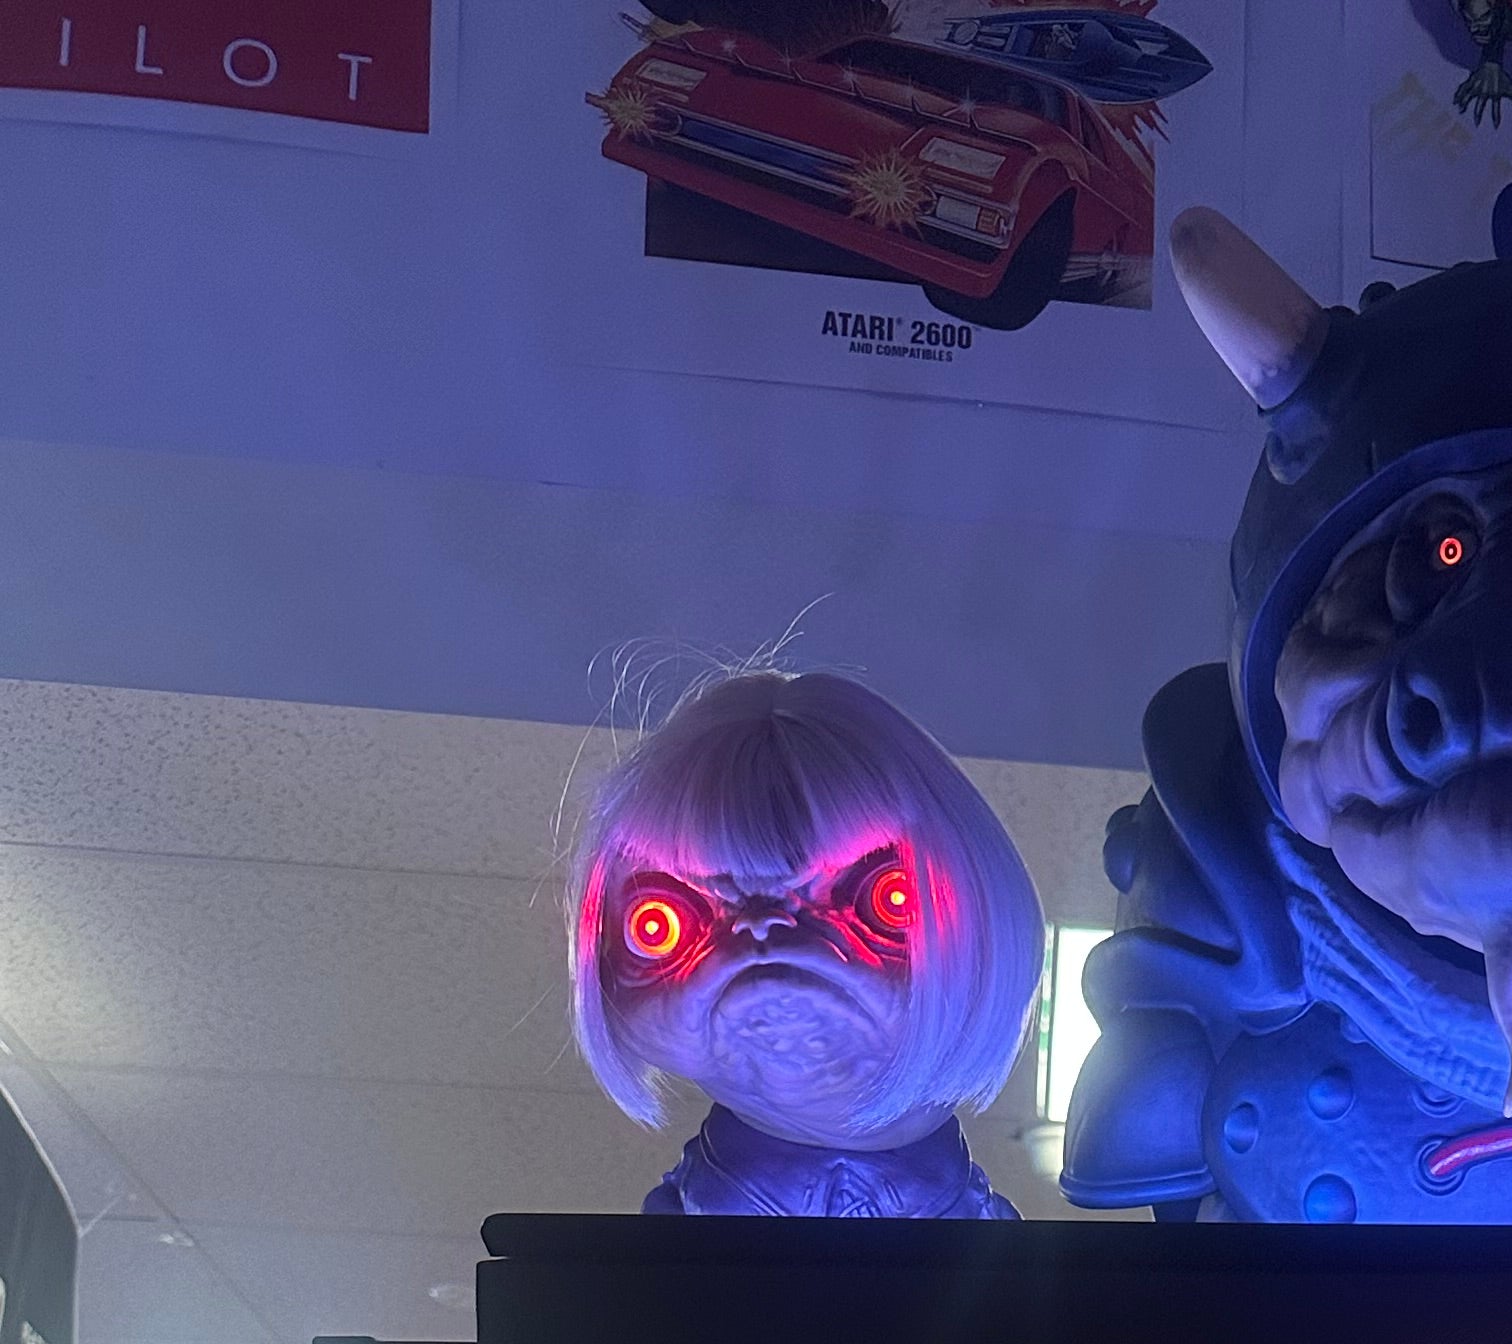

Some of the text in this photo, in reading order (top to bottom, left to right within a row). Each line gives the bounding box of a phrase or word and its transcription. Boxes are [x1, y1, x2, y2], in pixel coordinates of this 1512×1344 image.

[821, 310, 972, 349] ATARI 2600
[849, 341, 953, 362] AND COMPATIBLES
